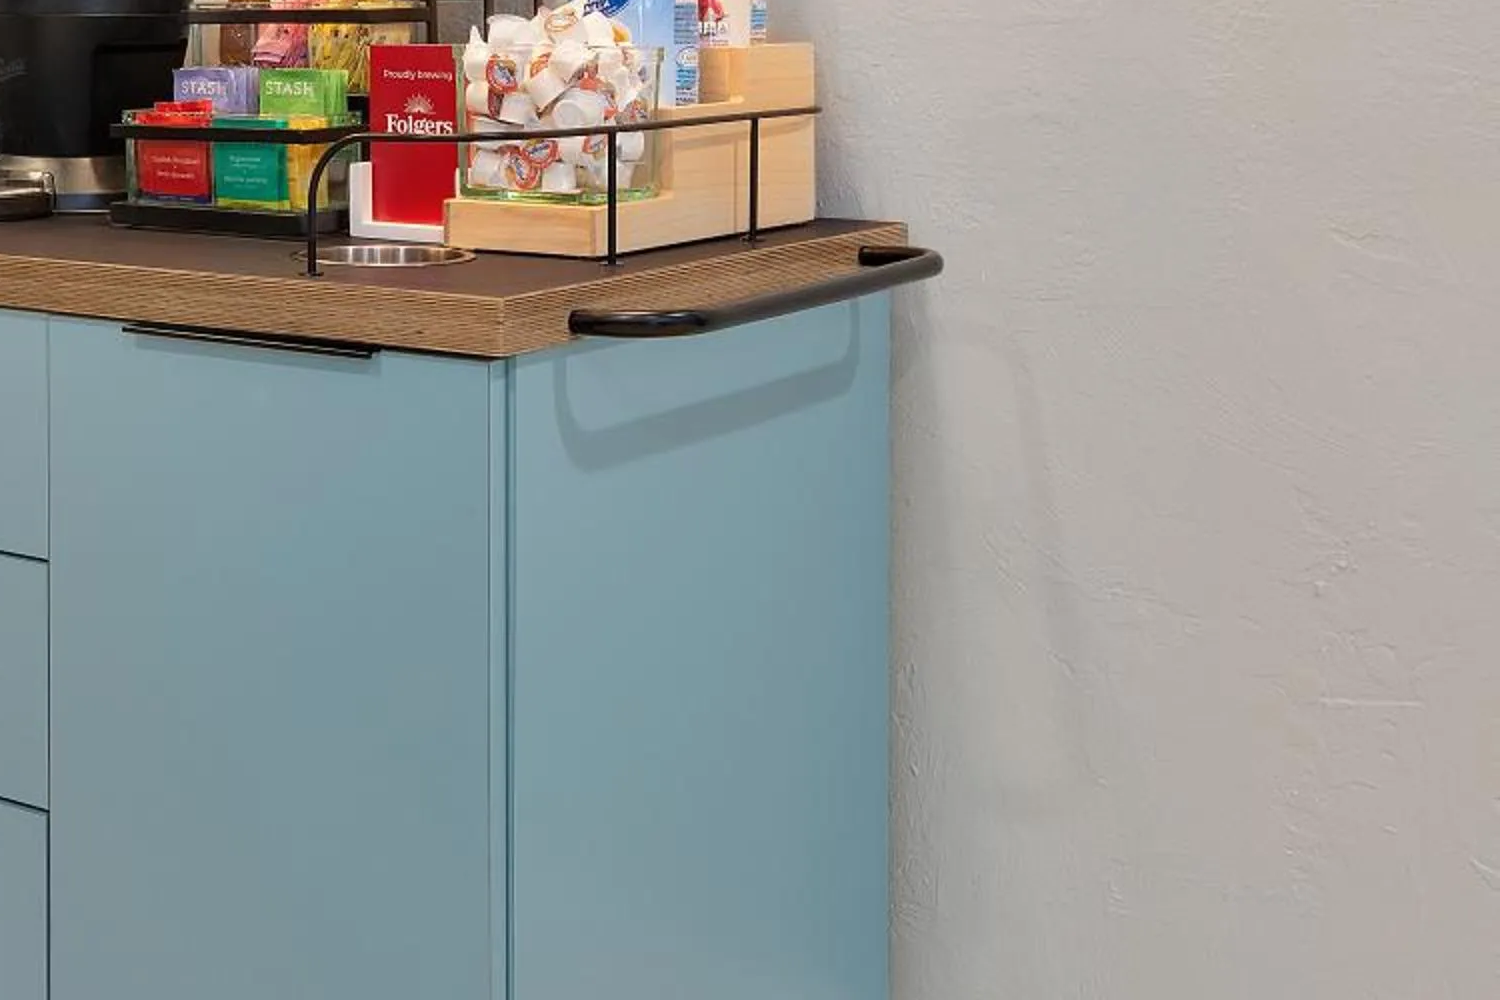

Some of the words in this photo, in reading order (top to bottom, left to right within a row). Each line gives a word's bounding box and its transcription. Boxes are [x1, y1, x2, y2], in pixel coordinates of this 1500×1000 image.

[383, 69, 416, 81] Proudly
[418, 70, 453, 82] brewing
[181, 80, 228, 96] STASH
[265, 81, 313, 96] STASH
[384, 113, 453, 136] Folgers
